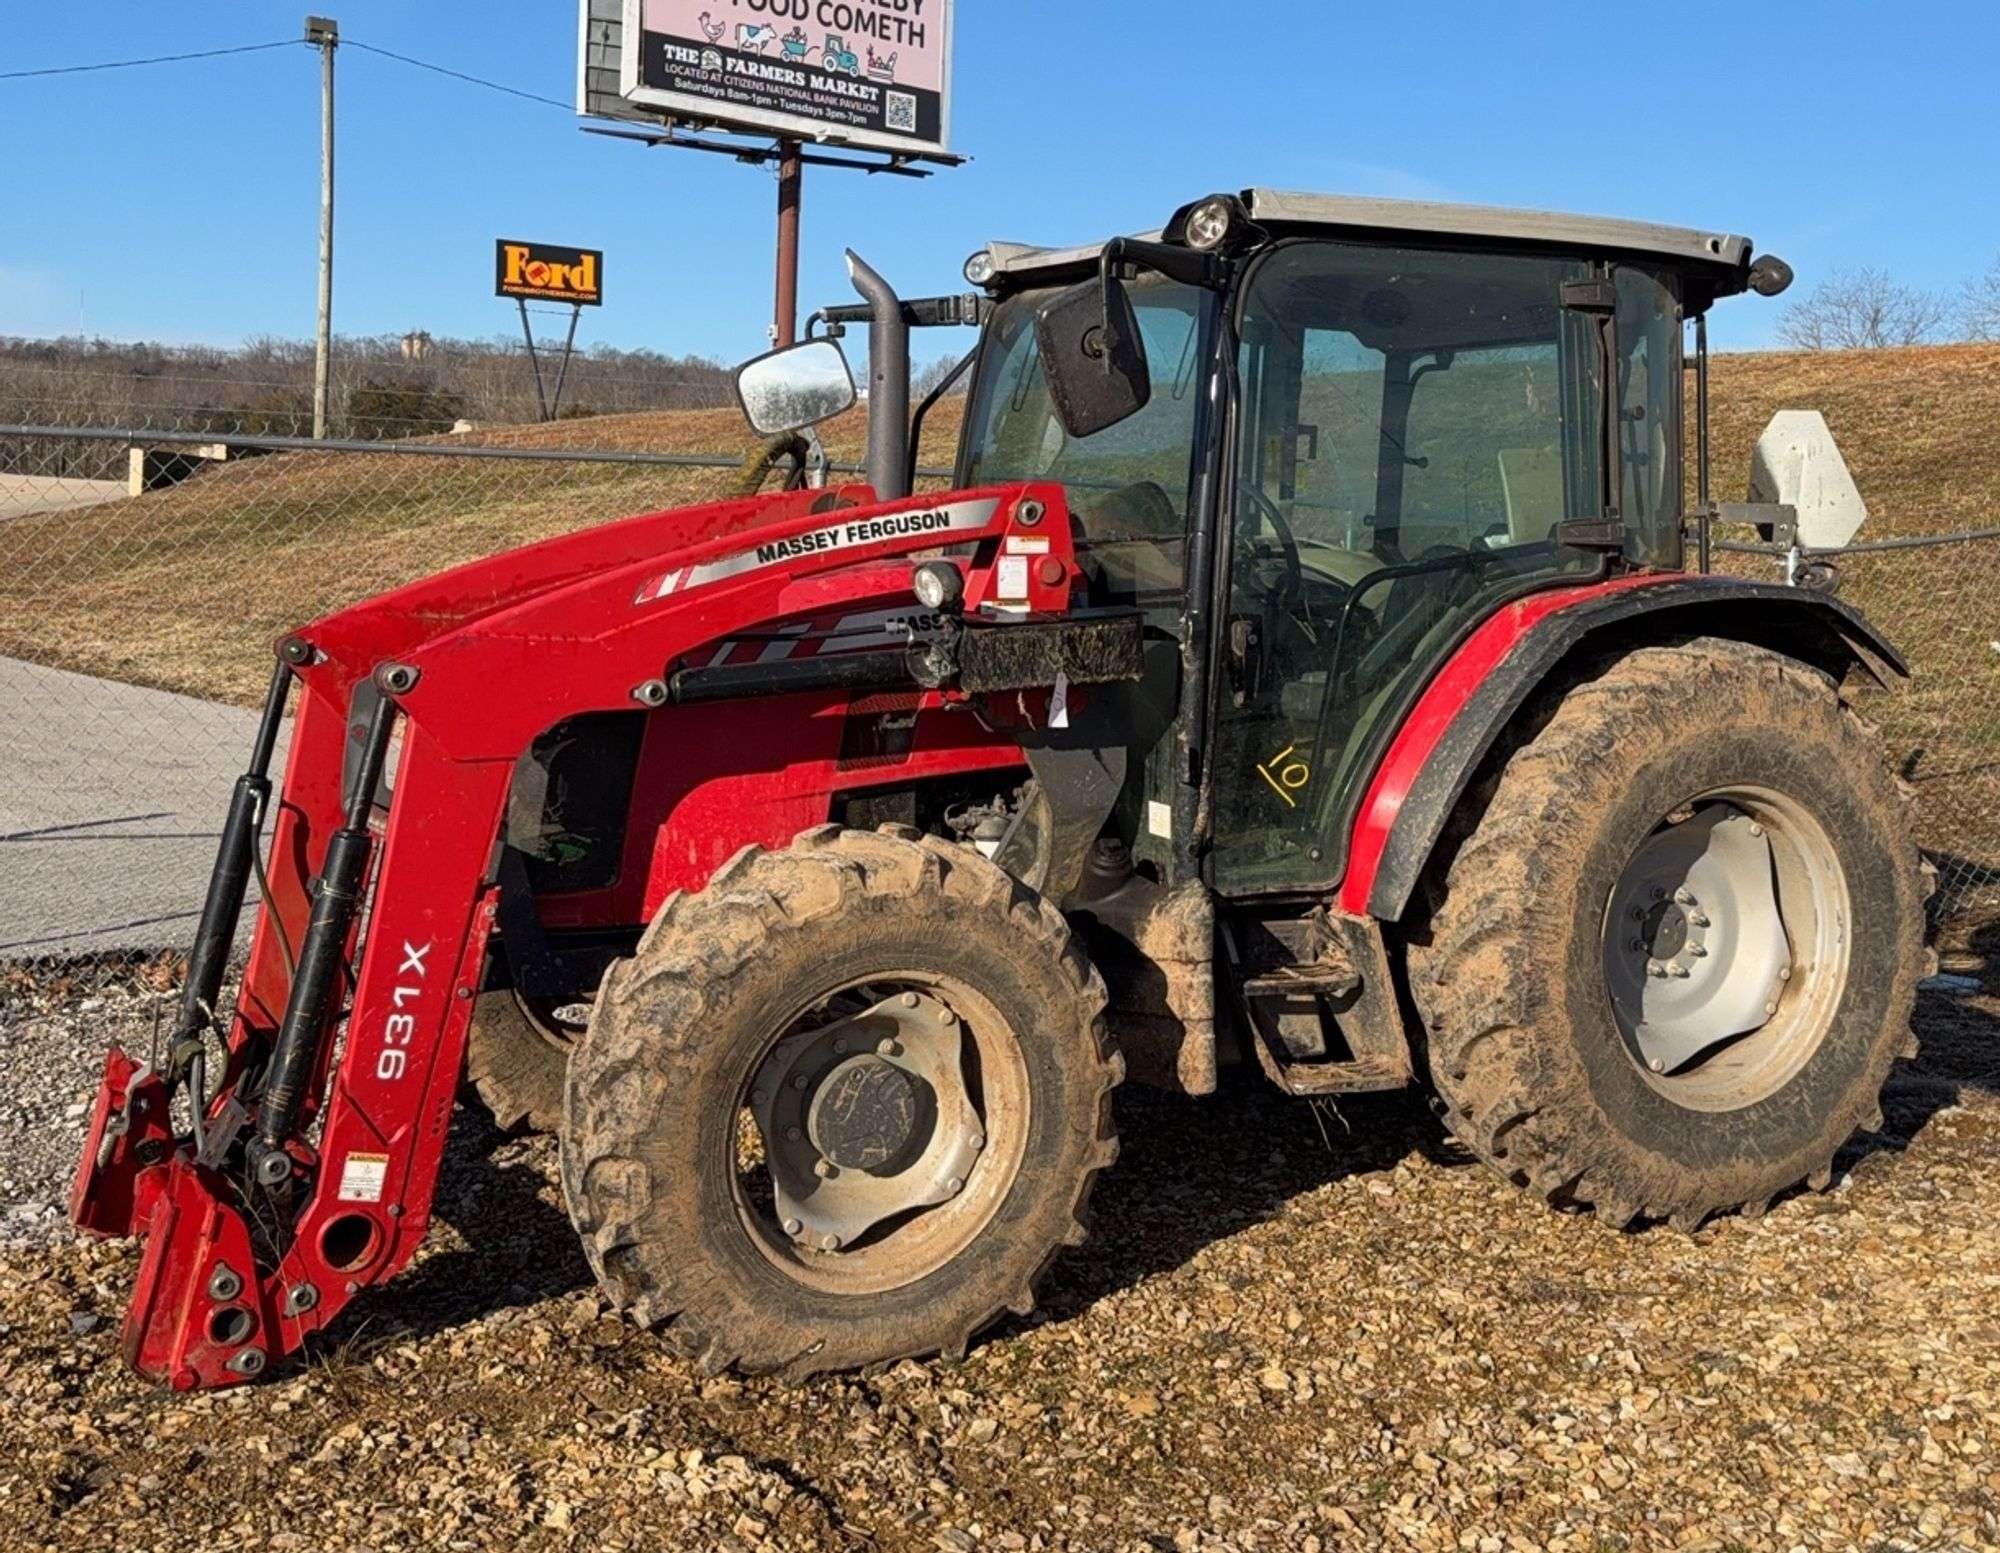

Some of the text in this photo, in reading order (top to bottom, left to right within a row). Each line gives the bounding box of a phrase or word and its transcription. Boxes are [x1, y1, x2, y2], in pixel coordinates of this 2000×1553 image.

[817, 1, 924, 48] COMETH
[663, 44, 880, 101] THE FARMERS MARKET
[664, 63, 708, 80] LOCATED
[710, 73, 722, 82] AT
[724, 75, 765, 92] CITIZENS
[766, 84, 812, 101] NATIONAL
[840, 98, 880, 114] PAVILION
[674, 77, 725, 97] Saturdays
[780, 99, 823, 117] Tuesdays
[503, 245, 596, 292] Ford
[756, 511, 950, 564] MASSEY FERGUSON
